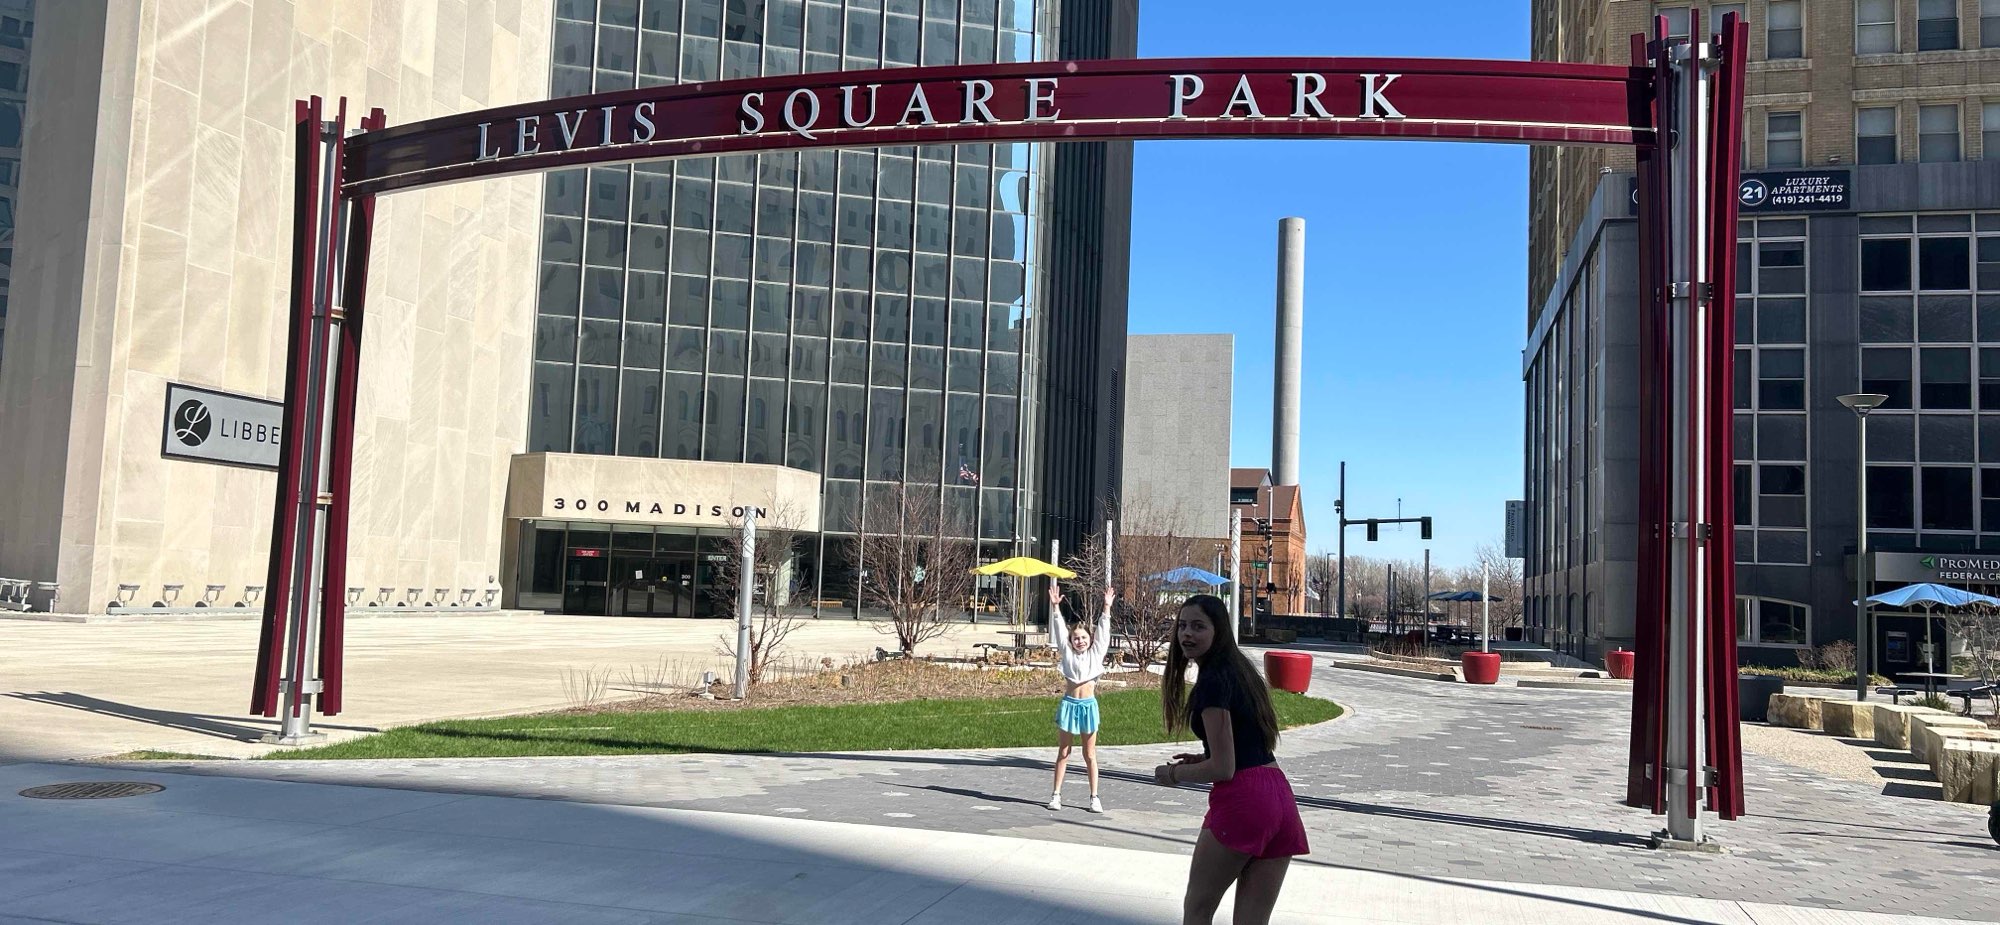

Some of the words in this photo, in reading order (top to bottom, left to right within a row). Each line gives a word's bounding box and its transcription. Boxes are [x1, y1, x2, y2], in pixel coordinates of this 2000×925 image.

[477, 102, 656, 161] LEVIS
[740, 77, 1061, 140] SQUARE
[1168, 73, 1407, 119] PARK
[1785, 177, 1830, 186] LUXURY
[1742, 186, 1763, 199] 21
[1771, 185, 1844, 195] APARTMENTS
[1772, 195, 1797, 205] (419)
[1798, 194, 1843, 203] 241-4419
[220, 418, 280, 445] LIBBE
[554, 498, 609, 512] 300
[625, 500, 767, 519] MADISON
[1940, 571, 1986, 580] FEDERAL
